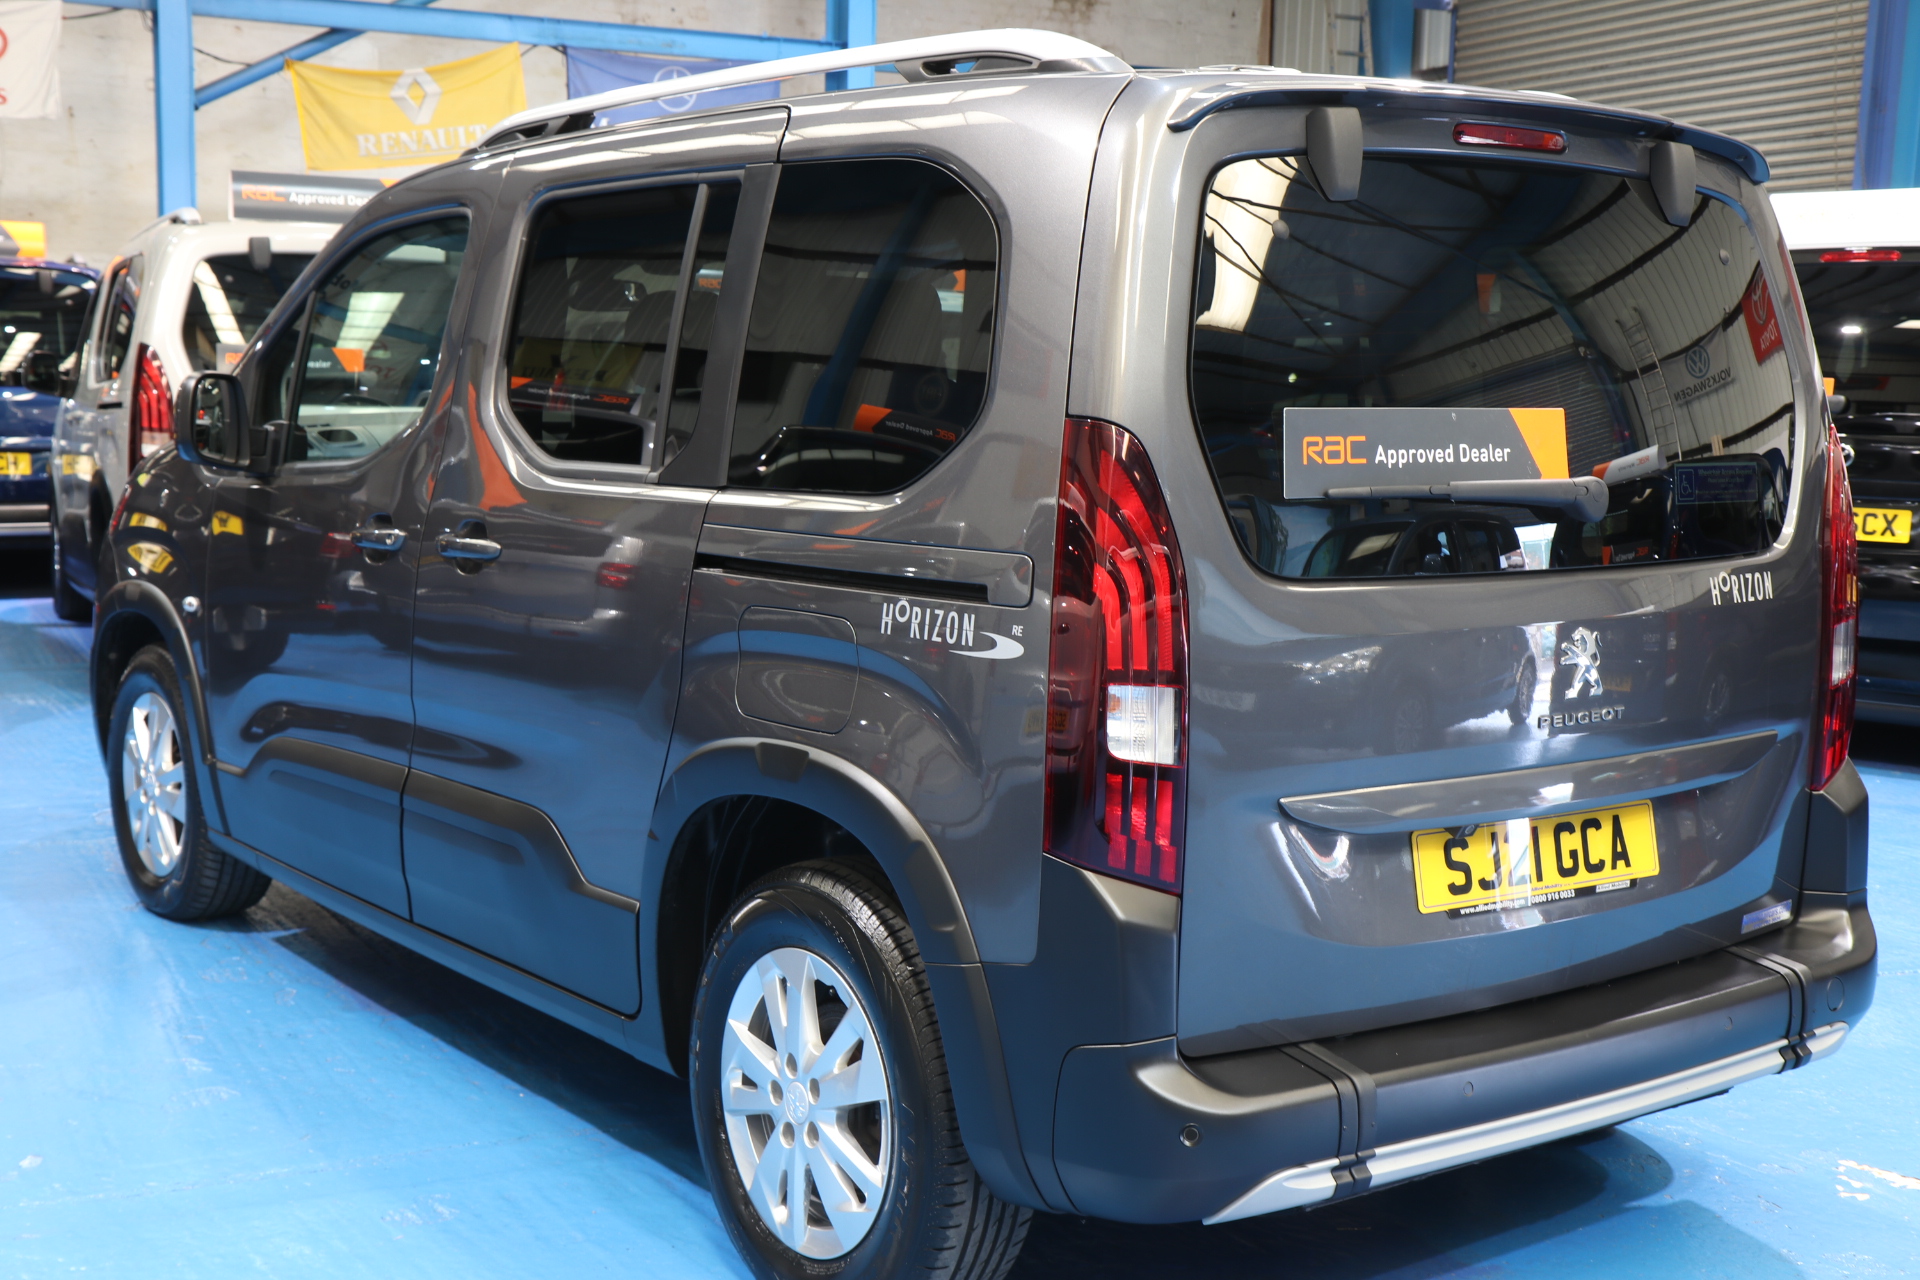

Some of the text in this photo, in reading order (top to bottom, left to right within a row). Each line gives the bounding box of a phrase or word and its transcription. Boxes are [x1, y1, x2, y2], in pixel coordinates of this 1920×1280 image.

[355, 123, 487, 157] RENAULT
[289, 192, 345, 206] Approved
[1374, 444, 1454, 468] Approved
[1458, 443, 1511, 463] Dealer
[1709, 571, 1773, 606] HORIZON
[880, 599, 1024, 647] HORIZON RE
[1537, 704, 1625, 729] PEUGEOT
[1553, 814, 1632, 878] GCA
[1531, 893, 1547, 904] 0800
[1546, 891, 1560, 901] 916
[1559, 888, 1575, 899] 0033
